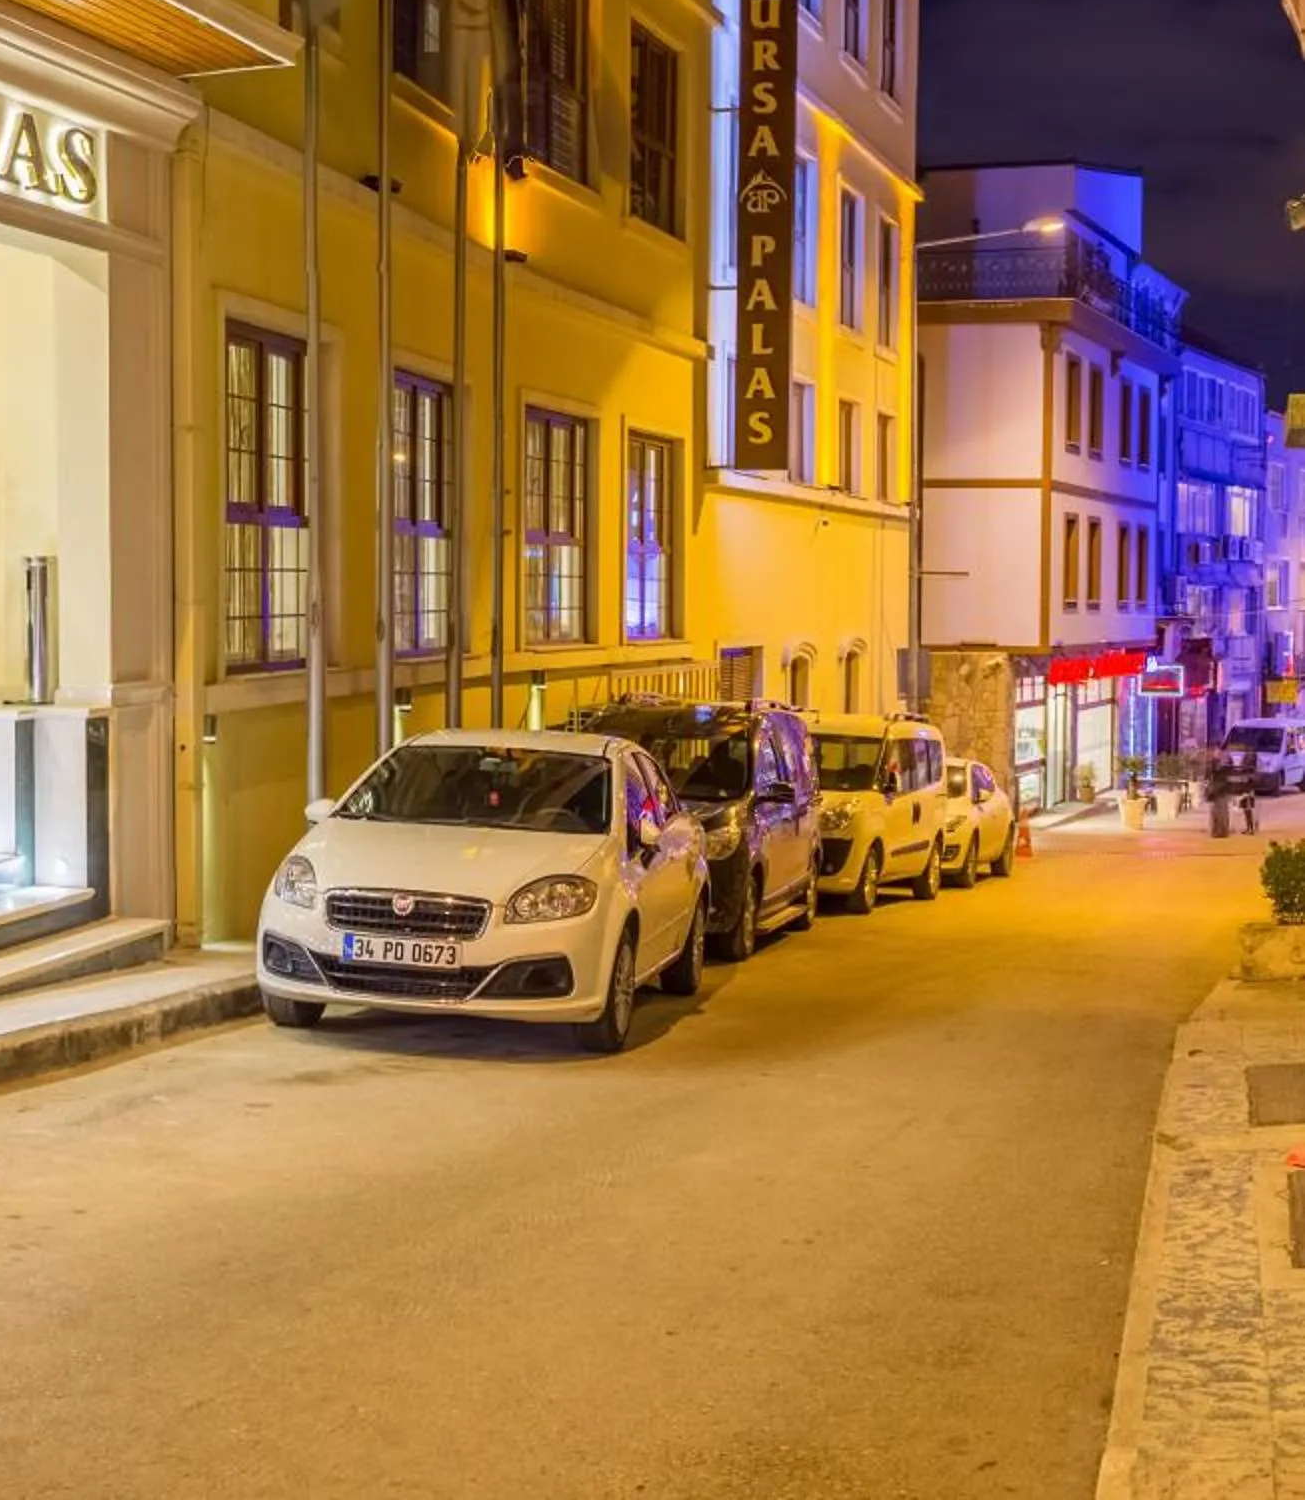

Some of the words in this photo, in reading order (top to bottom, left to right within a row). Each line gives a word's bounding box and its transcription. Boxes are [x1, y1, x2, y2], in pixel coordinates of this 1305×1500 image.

[746, 236, 778, 444] PALAS
[355, 939, 374, 958] 34
[412, 943, 456, 965] 0673
